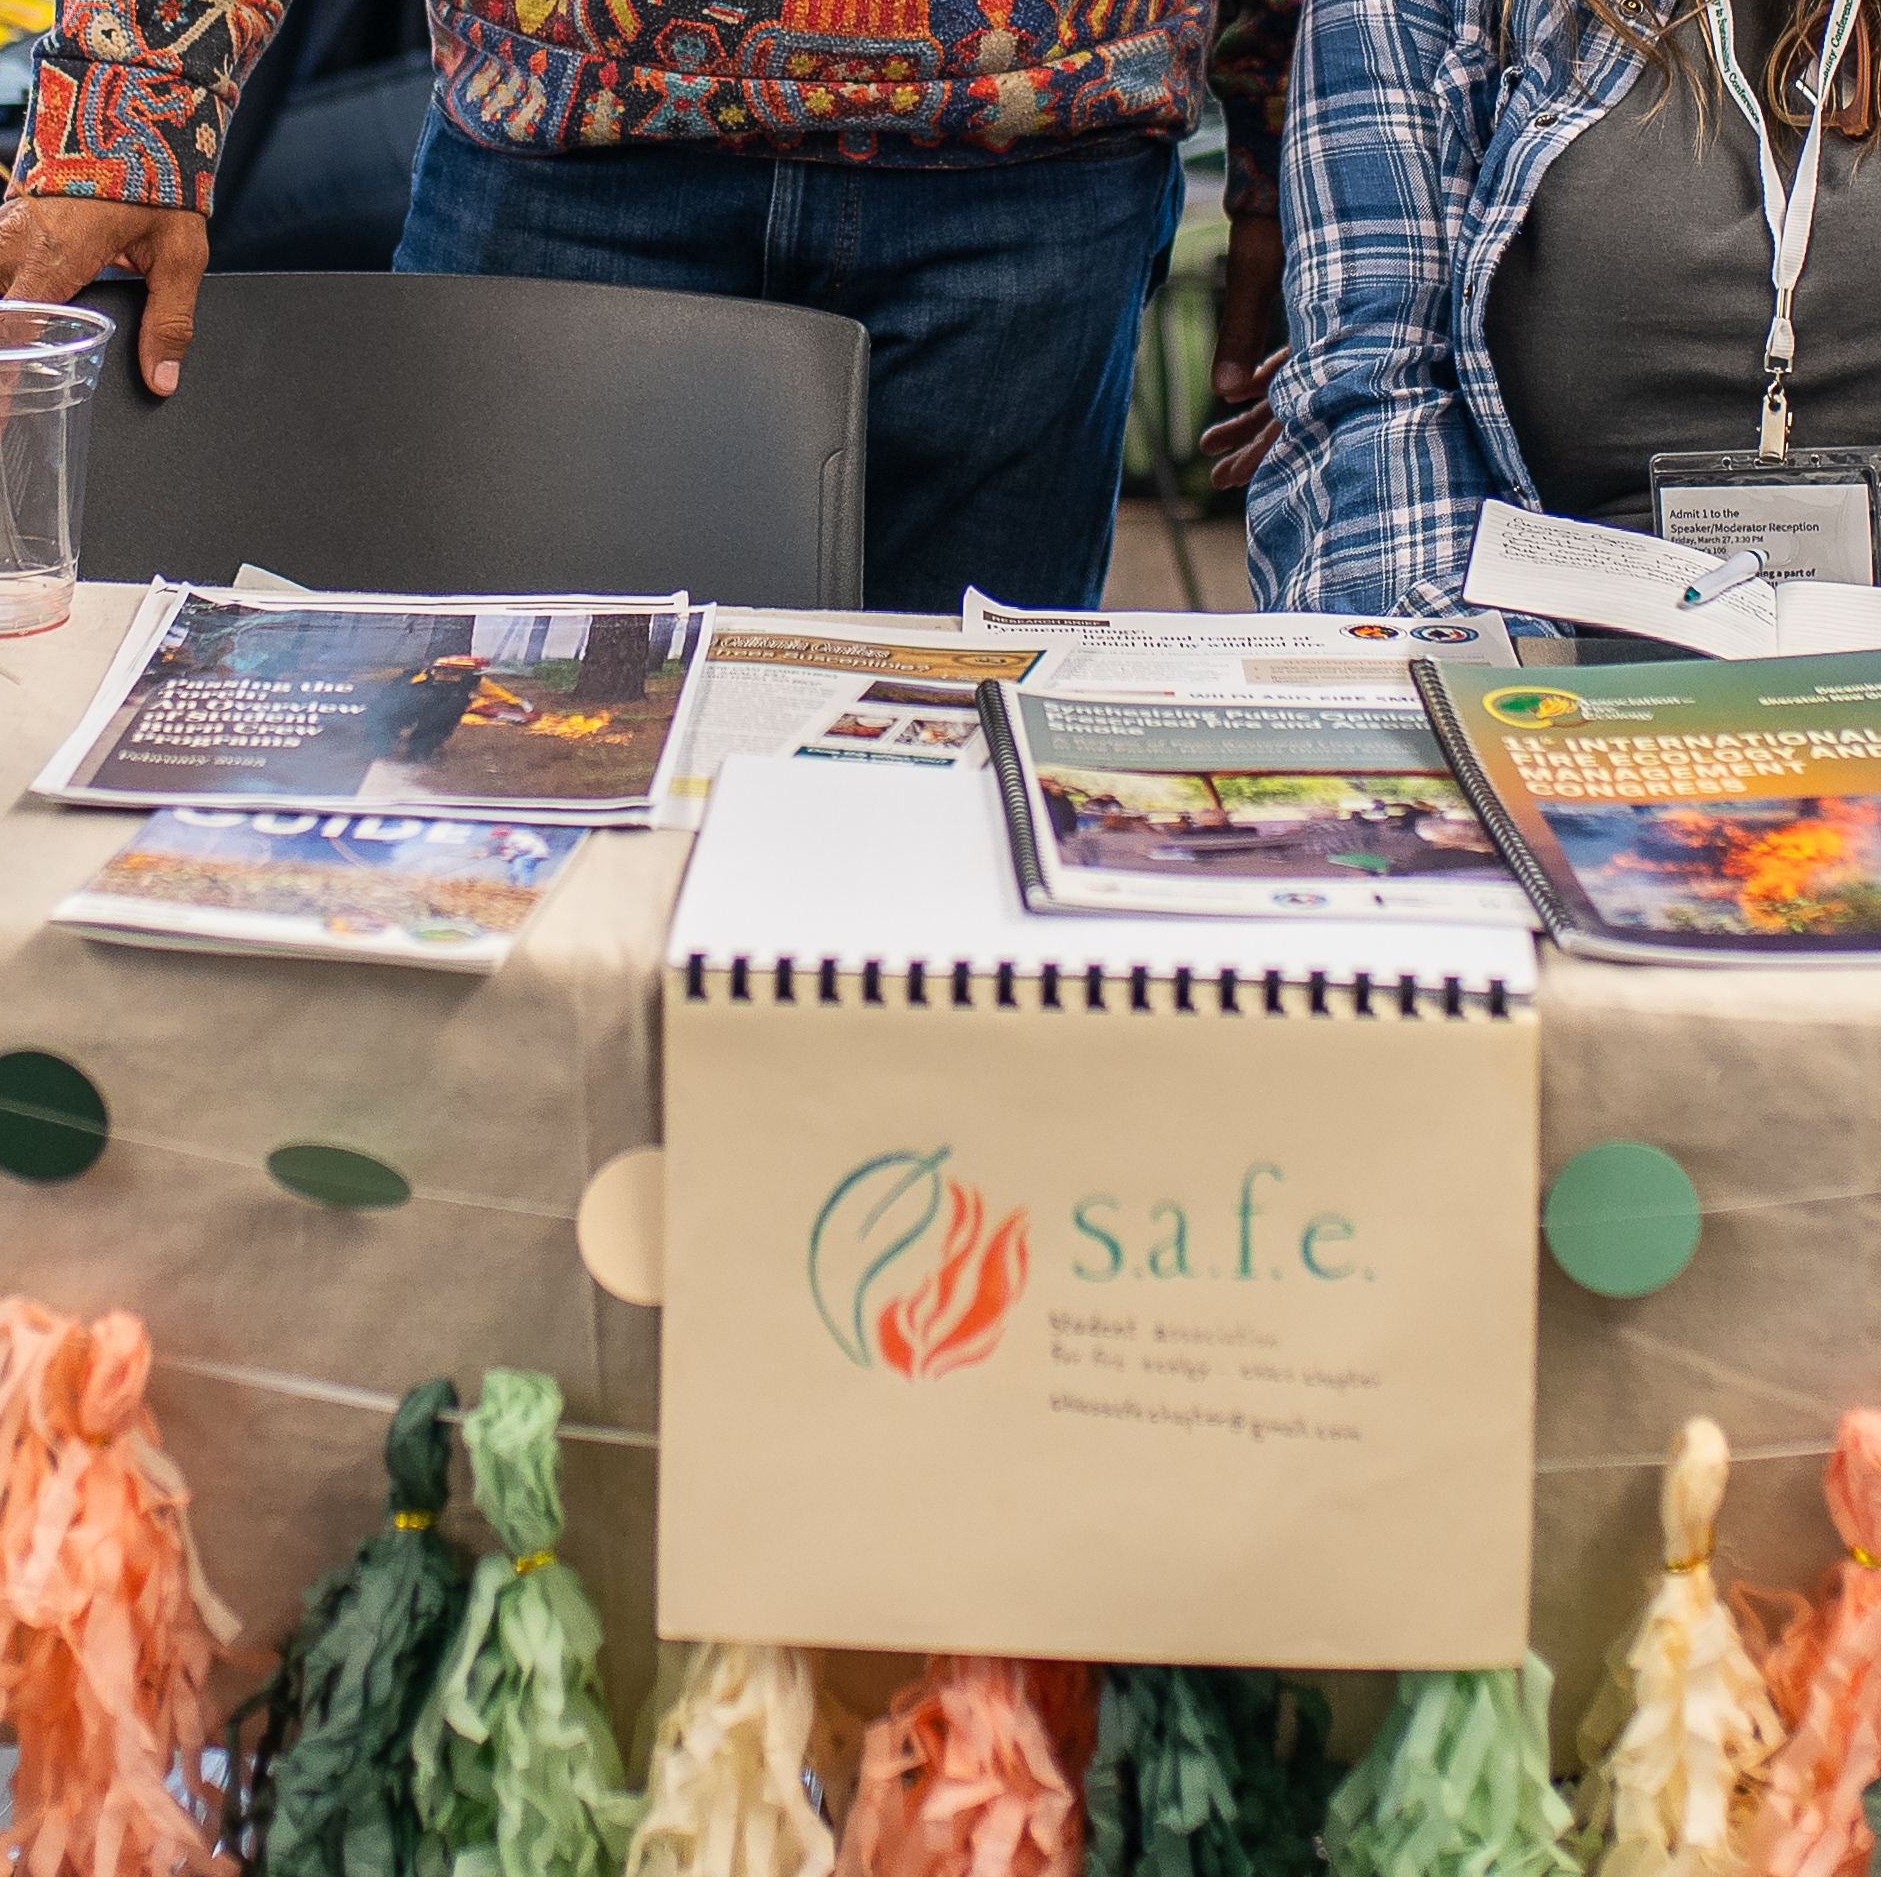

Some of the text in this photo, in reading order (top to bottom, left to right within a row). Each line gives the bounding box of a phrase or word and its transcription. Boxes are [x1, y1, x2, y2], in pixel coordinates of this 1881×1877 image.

[1728, 73, 1761, 125] Conference
[1670, 509, 1740, 519] Admit 1 to the
[1670, 522, 1820, 535] Speaker/Moderator Reception
[1698, 535, 1720, 544] March
[1752, 535, 1764, 543] PM
[1776, 570, 1783, 578] a
[1784, 568, 1803, 579] part
[1803, 568, 1816, 577] of
[167, 678, 354, 694] Passing the
[148, 699, 367, 715] An Overview
[1042, 700, 1218, 723] Synthesizing
[1225, 709, 1311, 722] Public
[185, 710, 319, 724] Student
[1046, 711, 1197, 729] Prescribed
[1207, 718, 1264, 730] Fire
[1276, 718, 1323, 731] and
[140, 722, 324, 736] Burn Crew
[1047, 723, 1145, 737] Smoke
[132, 732, 302, 748] Programs
[1509, 751, 1599, 768] FIRE
[1607, 746, 1797, 767] ECOLOGY
[1518, 760, 1807, 783] MANAGEMENT
[1525, 779, 1748, 798] CONGRESS
[1071, 1159, 1378, 1284] s.a.f.e.
